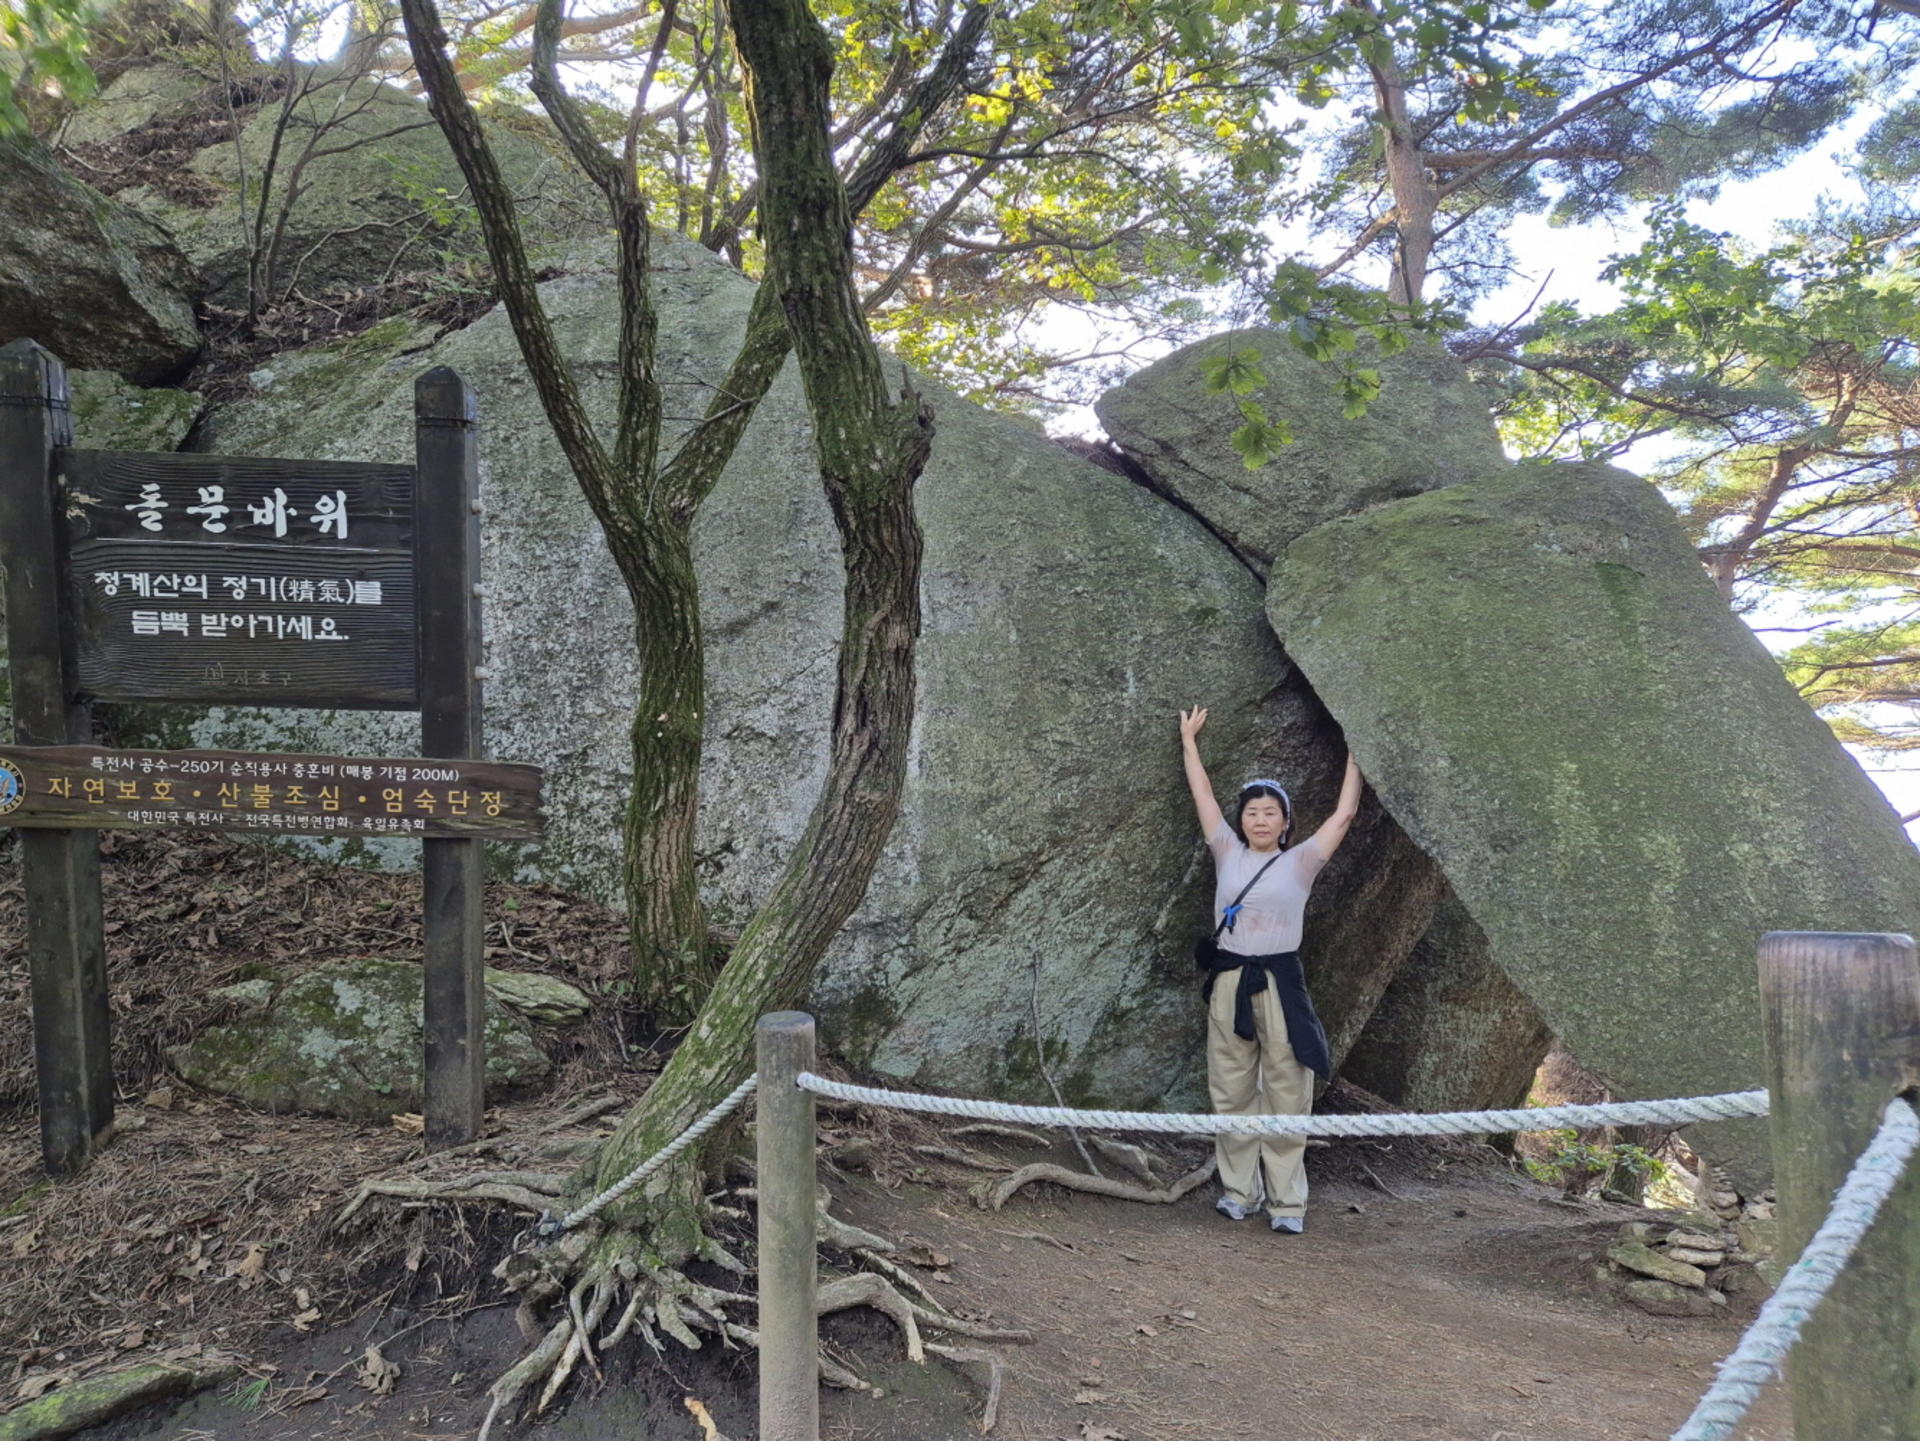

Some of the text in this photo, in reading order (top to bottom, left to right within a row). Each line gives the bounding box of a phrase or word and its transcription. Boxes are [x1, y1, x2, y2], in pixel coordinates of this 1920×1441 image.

[125, 483, 348, 540] 돌문바위
[131, 610, 350, 640] 듬뿍 받아가세요.
[90, 756, 460, 782] 특전사 공수-250기 순직용사 충혼비 (매봉 기점 200M)
[48, 777, 176, 805] 자연보호
[217, 782, 341, 811] 산불조심
[382, 788, 502, 816] 엄숙단정
[127, 810, 180, 825] 대한민국
[185, 811, 223, 826] 특전사
